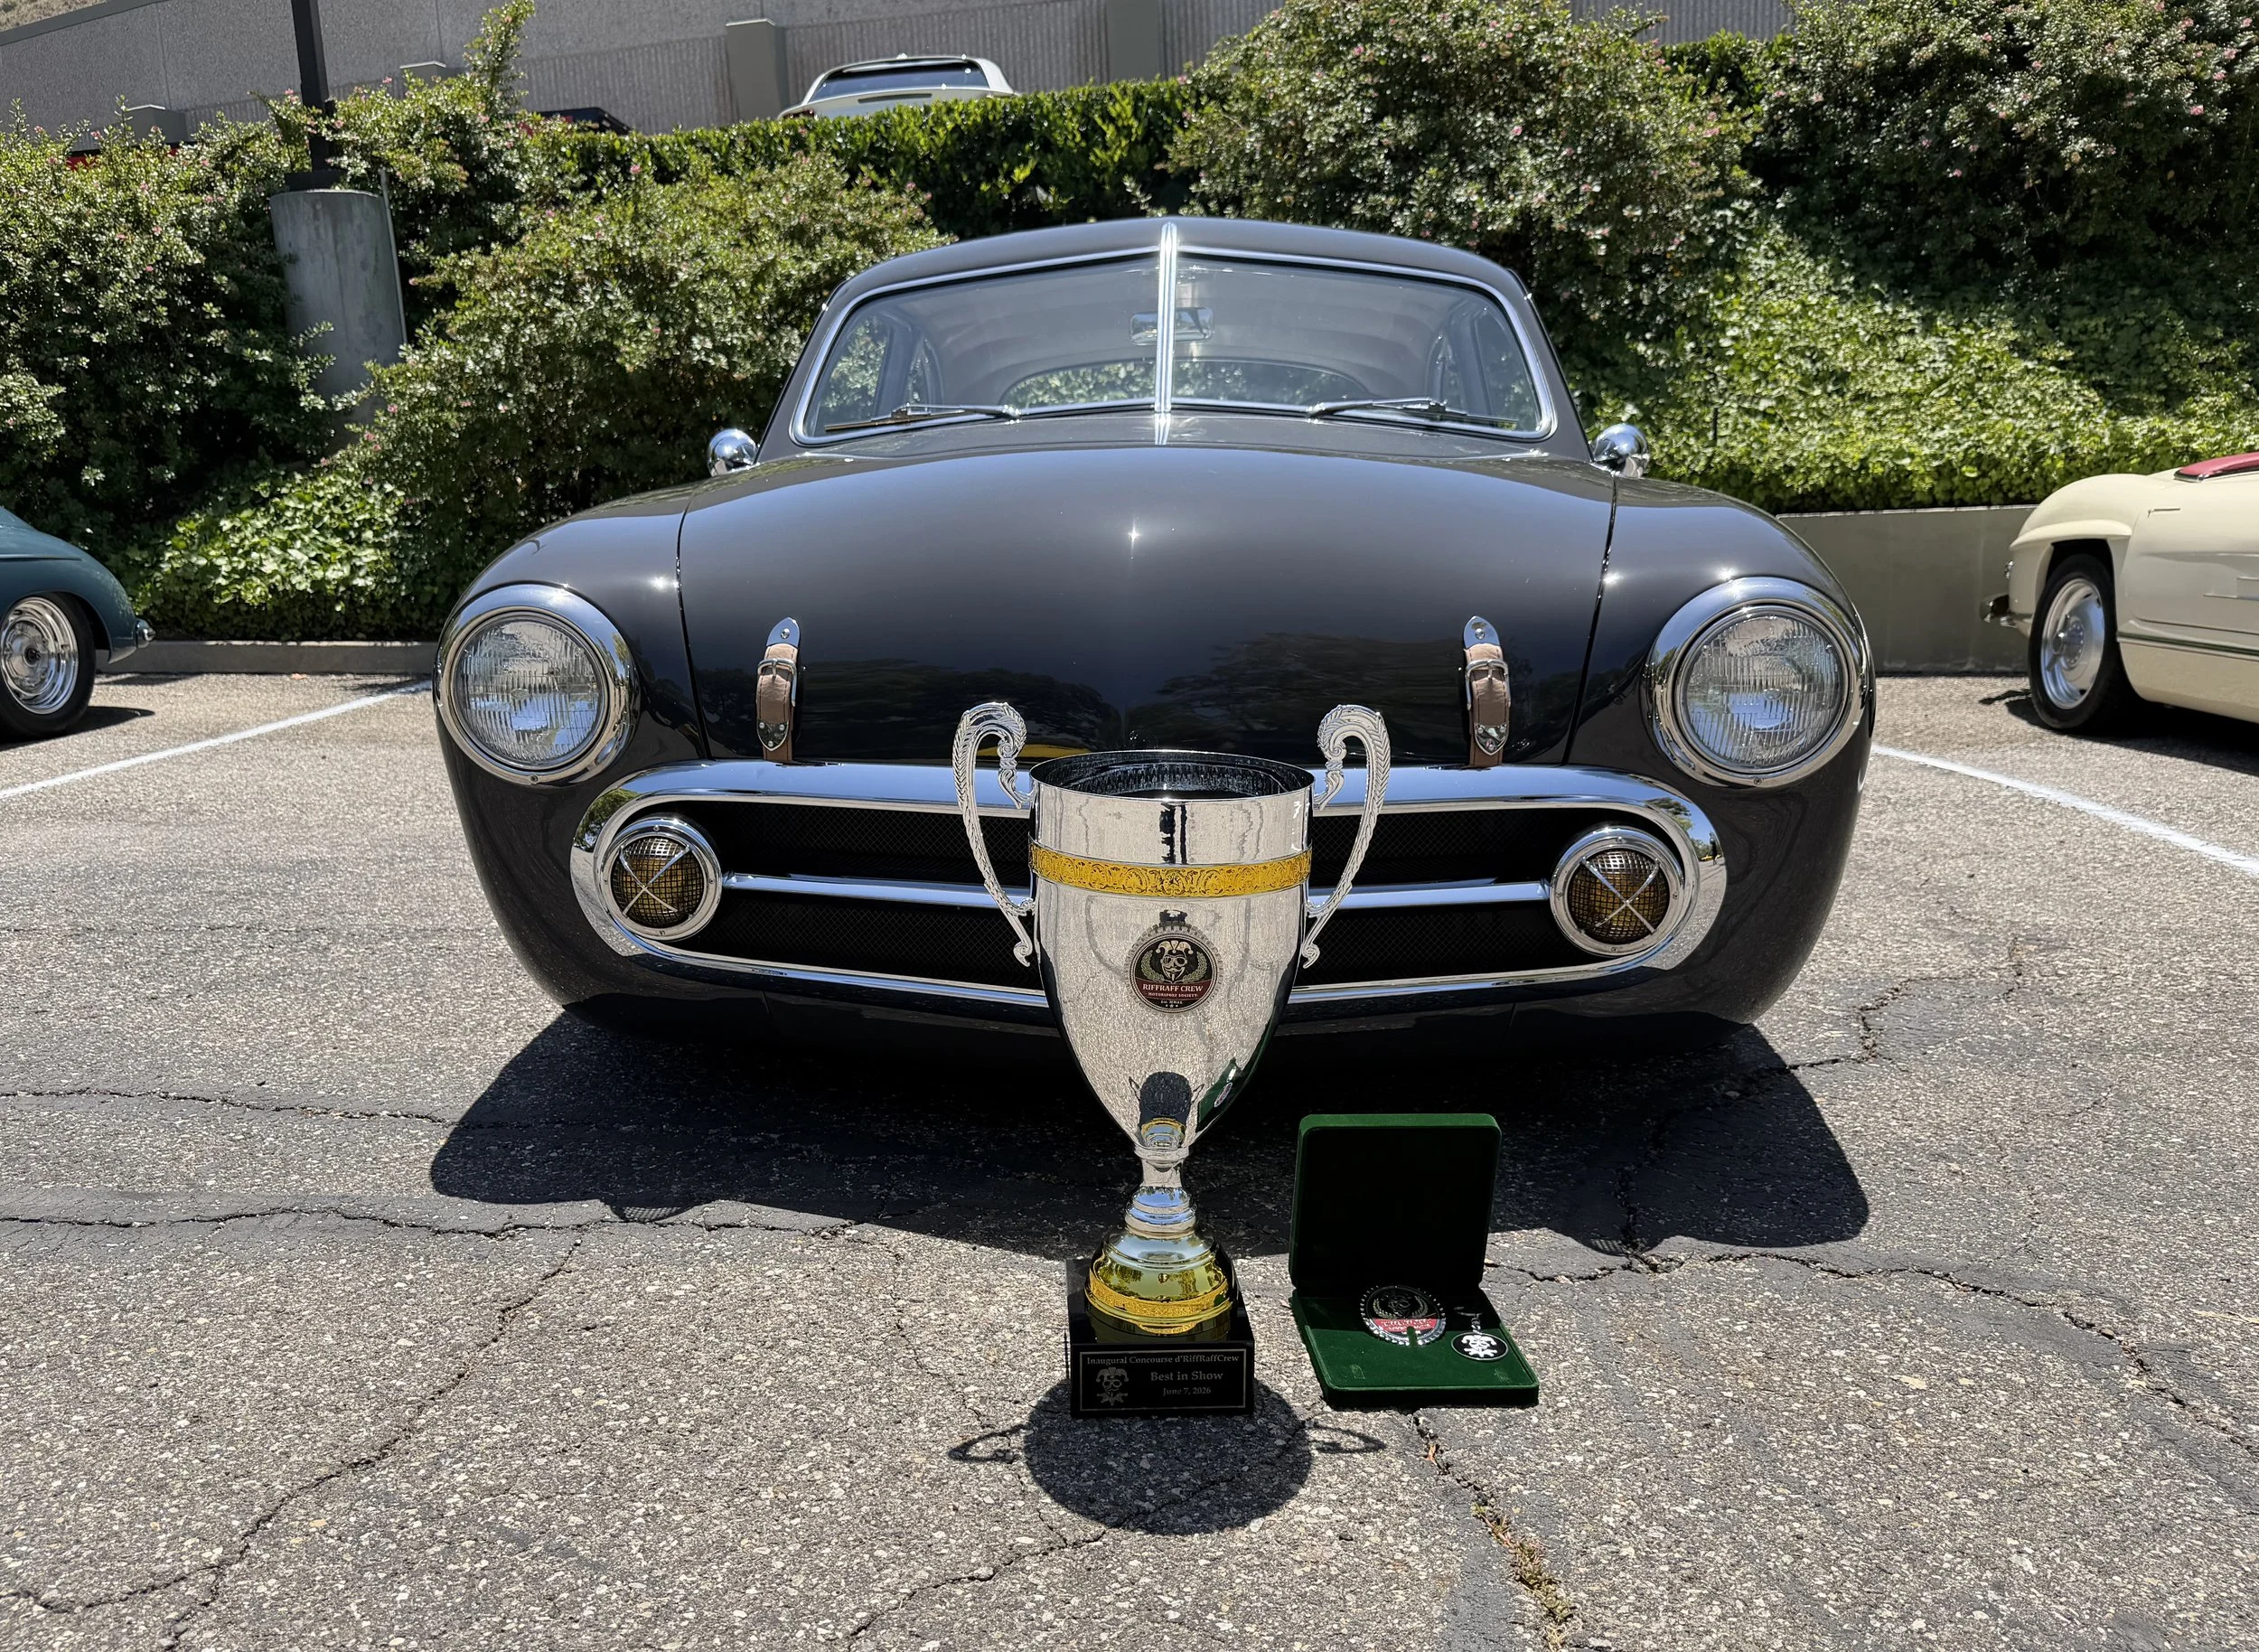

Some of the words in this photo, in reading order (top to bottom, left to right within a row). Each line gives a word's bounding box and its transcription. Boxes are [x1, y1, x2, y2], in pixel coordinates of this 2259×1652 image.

[1142, 983, 1179, 991] RIFFRAFF
[1087, 1356, 1127, 1366] Inaugural
[1130, 1356, 1173, 1364] Concourse
[1150, 1372, 1174, 1381] Best
[1176, 1371, 1188, 1381] in
[1191, 1371, 1223, 1381] Show
[1163, 1387, 1182, 1396] June
[1193, 1386, 1211, 1394] 2026
